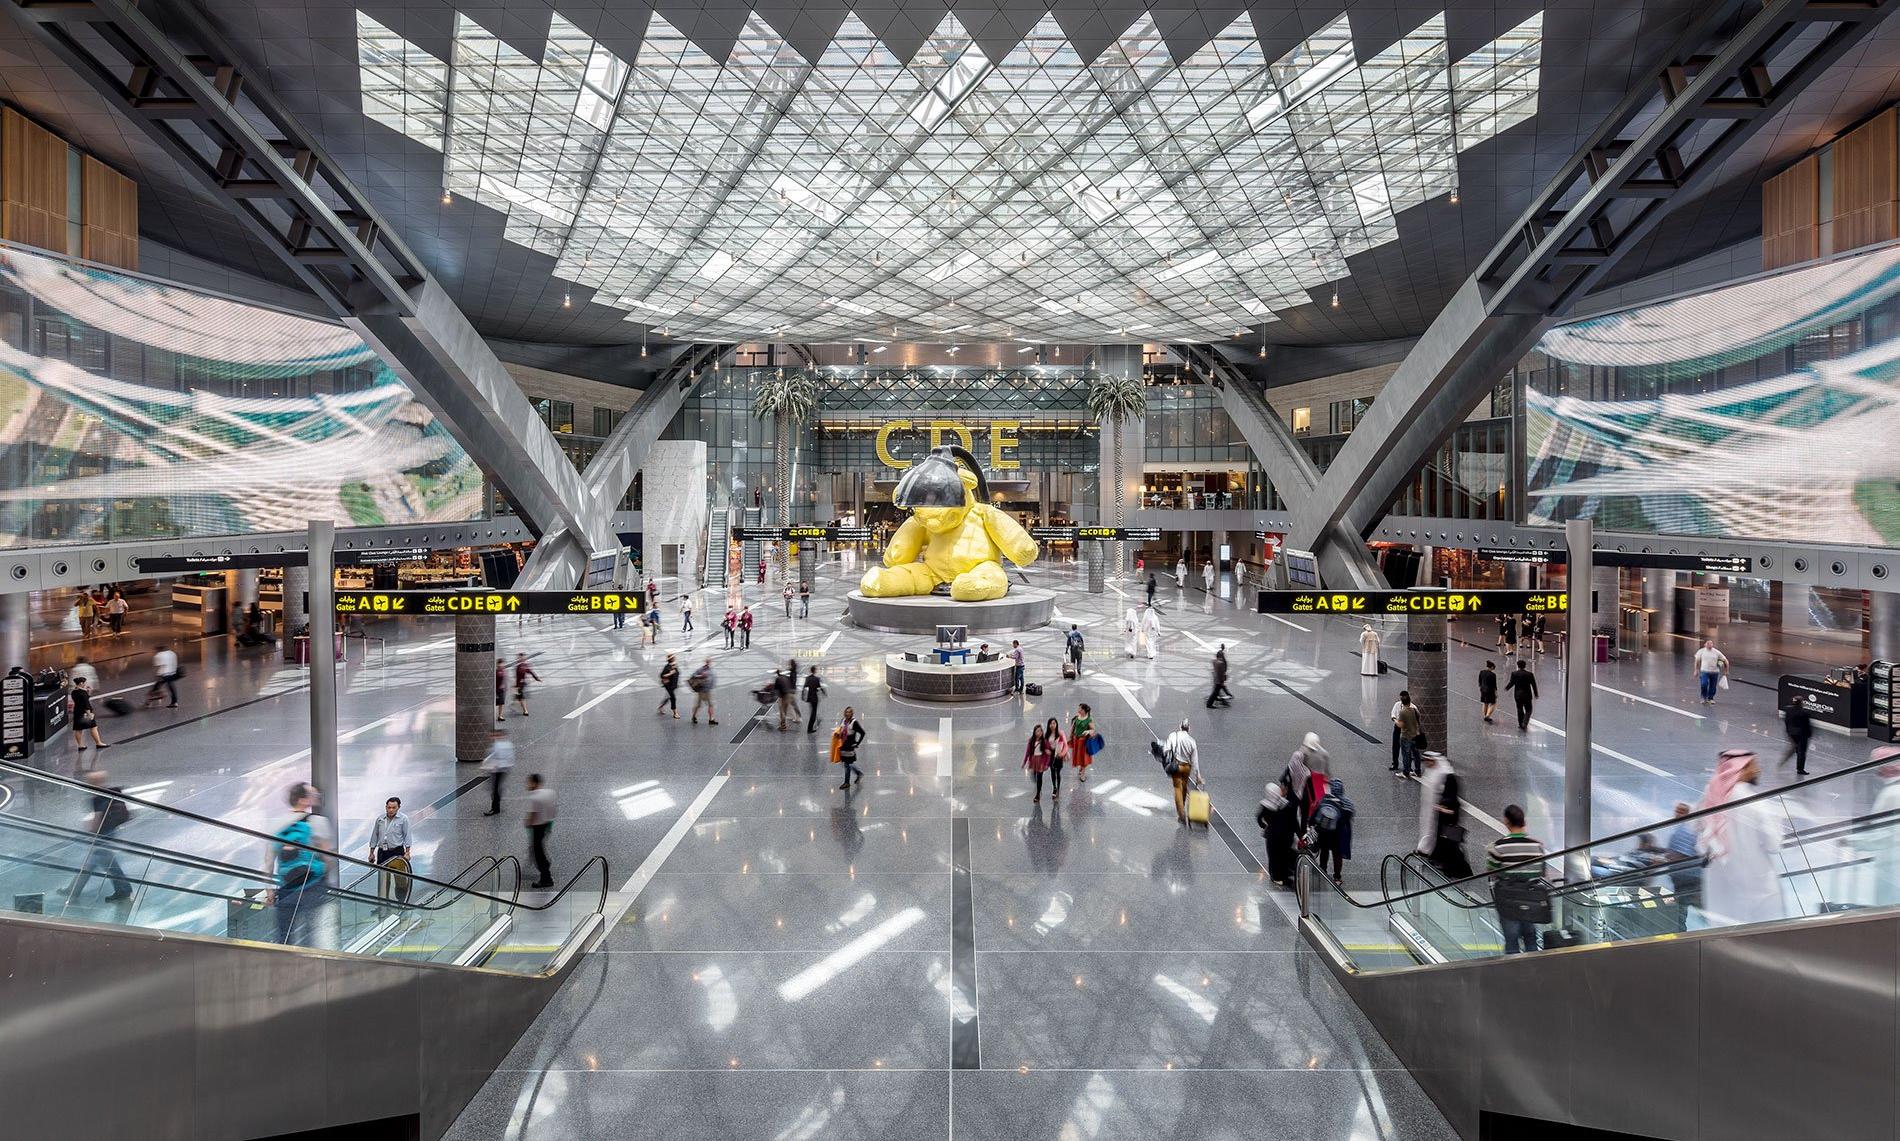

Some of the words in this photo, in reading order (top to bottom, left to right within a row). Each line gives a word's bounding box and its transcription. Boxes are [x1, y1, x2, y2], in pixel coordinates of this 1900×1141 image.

[358, 596, 371, 610] A
[591, 596, 601, 610] B
[1316, 596, 1329, 610] A
[1526, 603, 1545, 611] Gates
[1547, 596, 1557, 609] B
